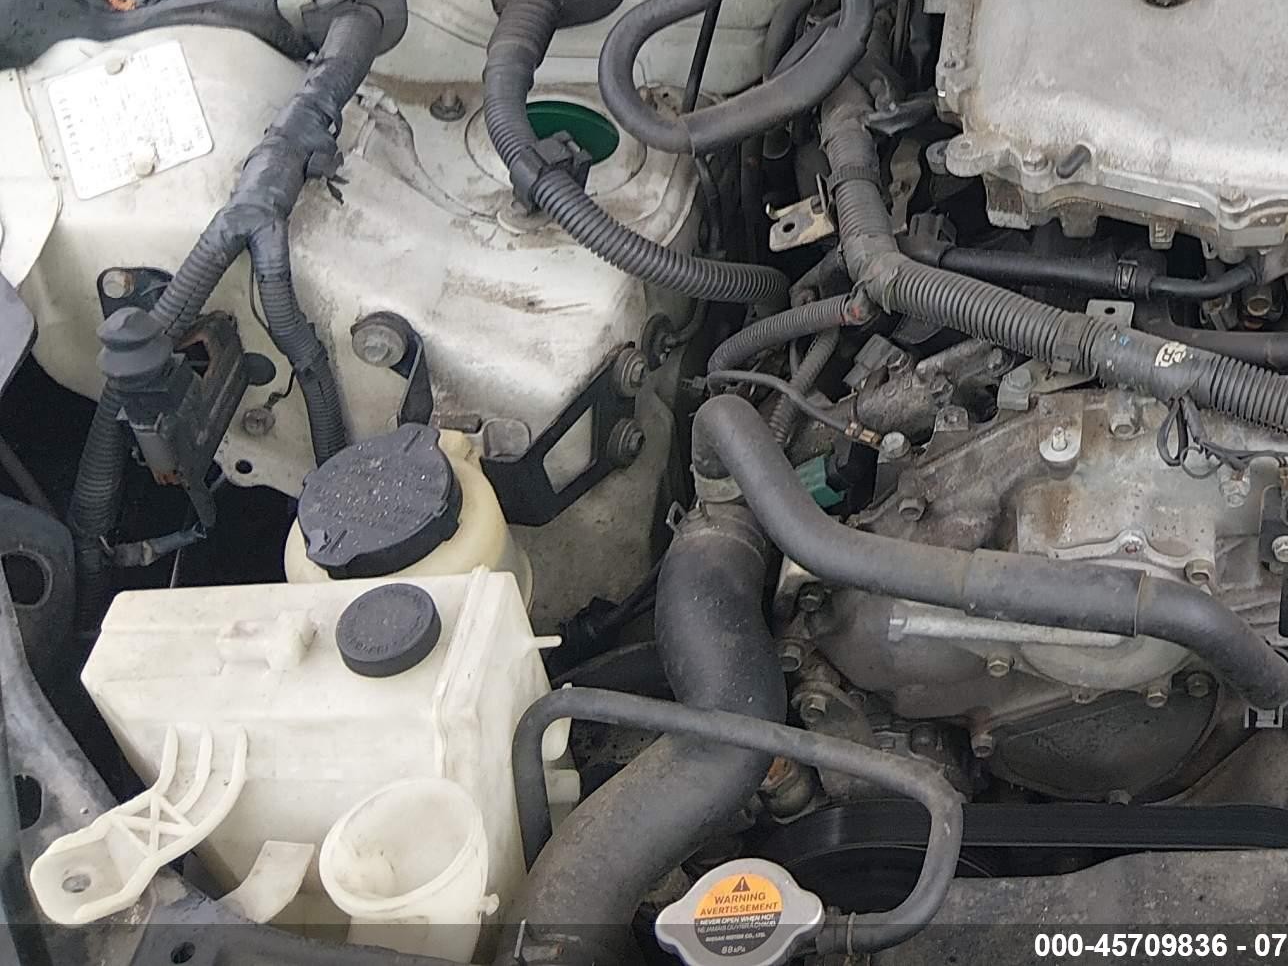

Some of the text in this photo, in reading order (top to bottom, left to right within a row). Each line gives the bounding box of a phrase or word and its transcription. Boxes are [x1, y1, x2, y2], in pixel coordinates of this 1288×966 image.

[714, 892, 766, 904] WARNING
[700, 902, 778, 915] AVERTISSEMENT
[722, 916, 739, 925] OPEN
[740, 914, 760, 924] WHEN
